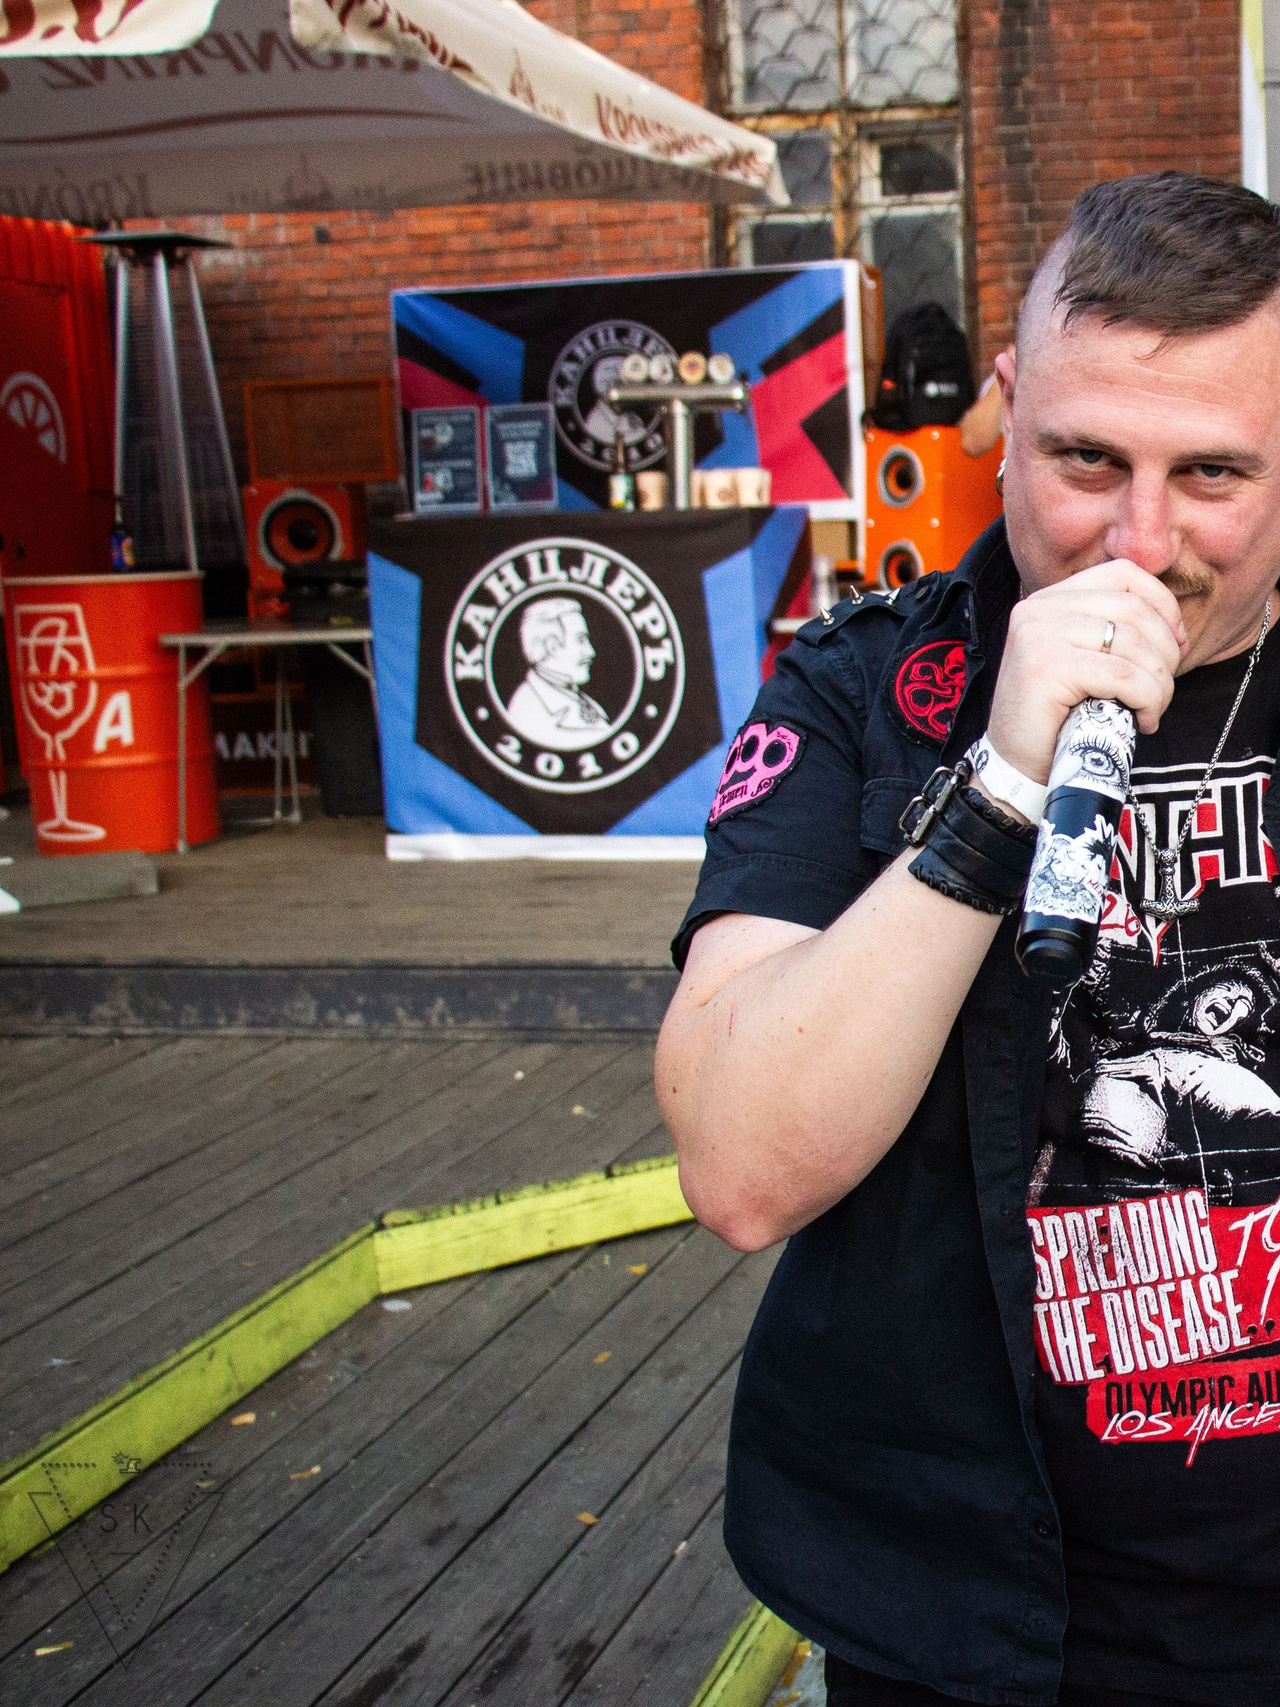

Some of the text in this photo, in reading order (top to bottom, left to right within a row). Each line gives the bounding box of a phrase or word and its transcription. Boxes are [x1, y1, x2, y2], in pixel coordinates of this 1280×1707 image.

[454, 549, 676, 682] КАНЦЛЕРЪ
[496, 732, 641, 778] 2010
[1028, 1191, 1218, 1300] SPREADING
[1034, 1269, 1250, 1382] THE DISEASE
[1101, 1410, 1173, 1443] LOS
[1105, 1374, 1236, 1420] OLYMPIC
